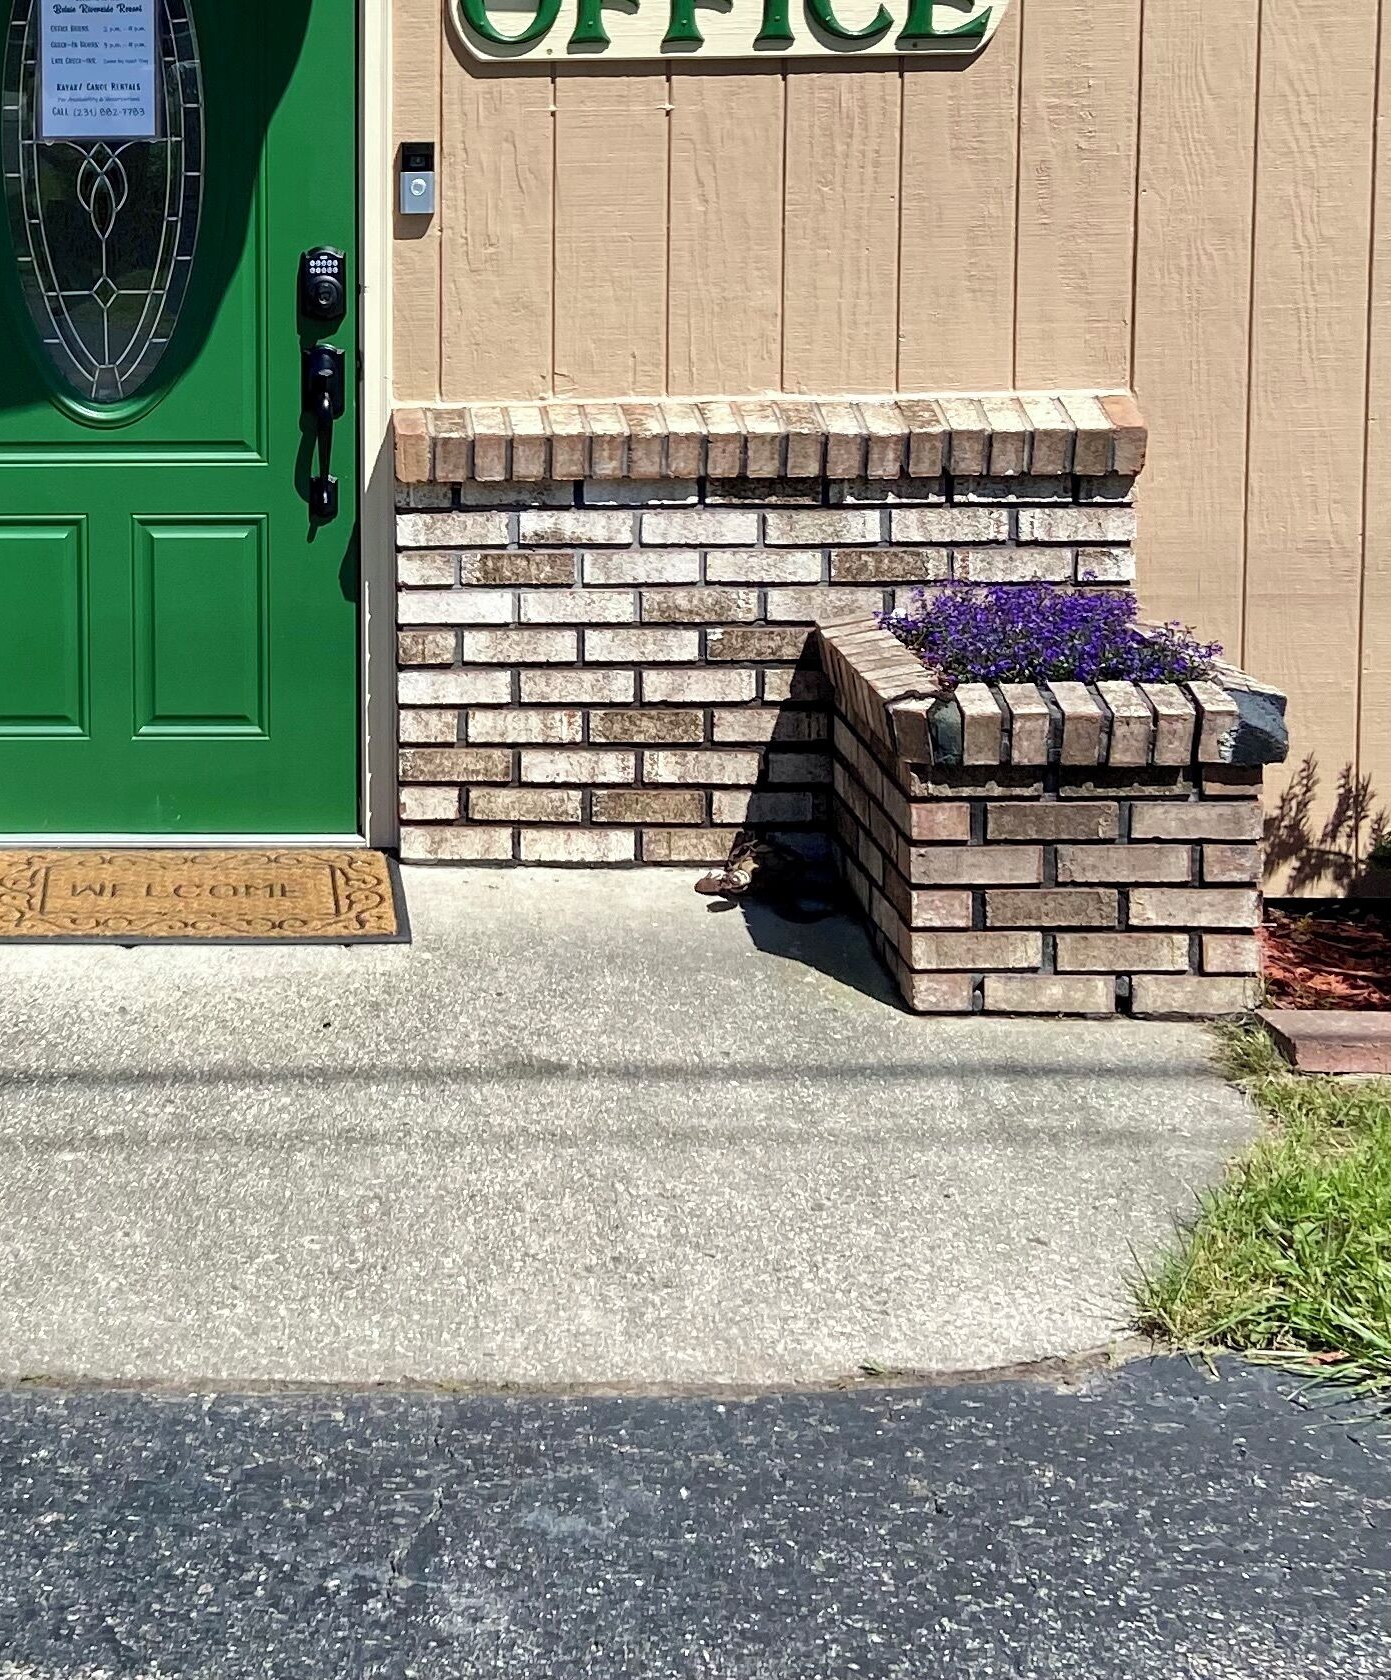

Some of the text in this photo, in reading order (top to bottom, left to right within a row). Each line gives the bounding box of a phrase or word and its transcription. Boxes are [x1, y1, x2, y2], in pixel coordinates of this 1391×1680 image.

[116, 3, 143, 13] Resort
[73, 107, 97, 117] (231)
[70, 881, 301, 899] WELCOME
